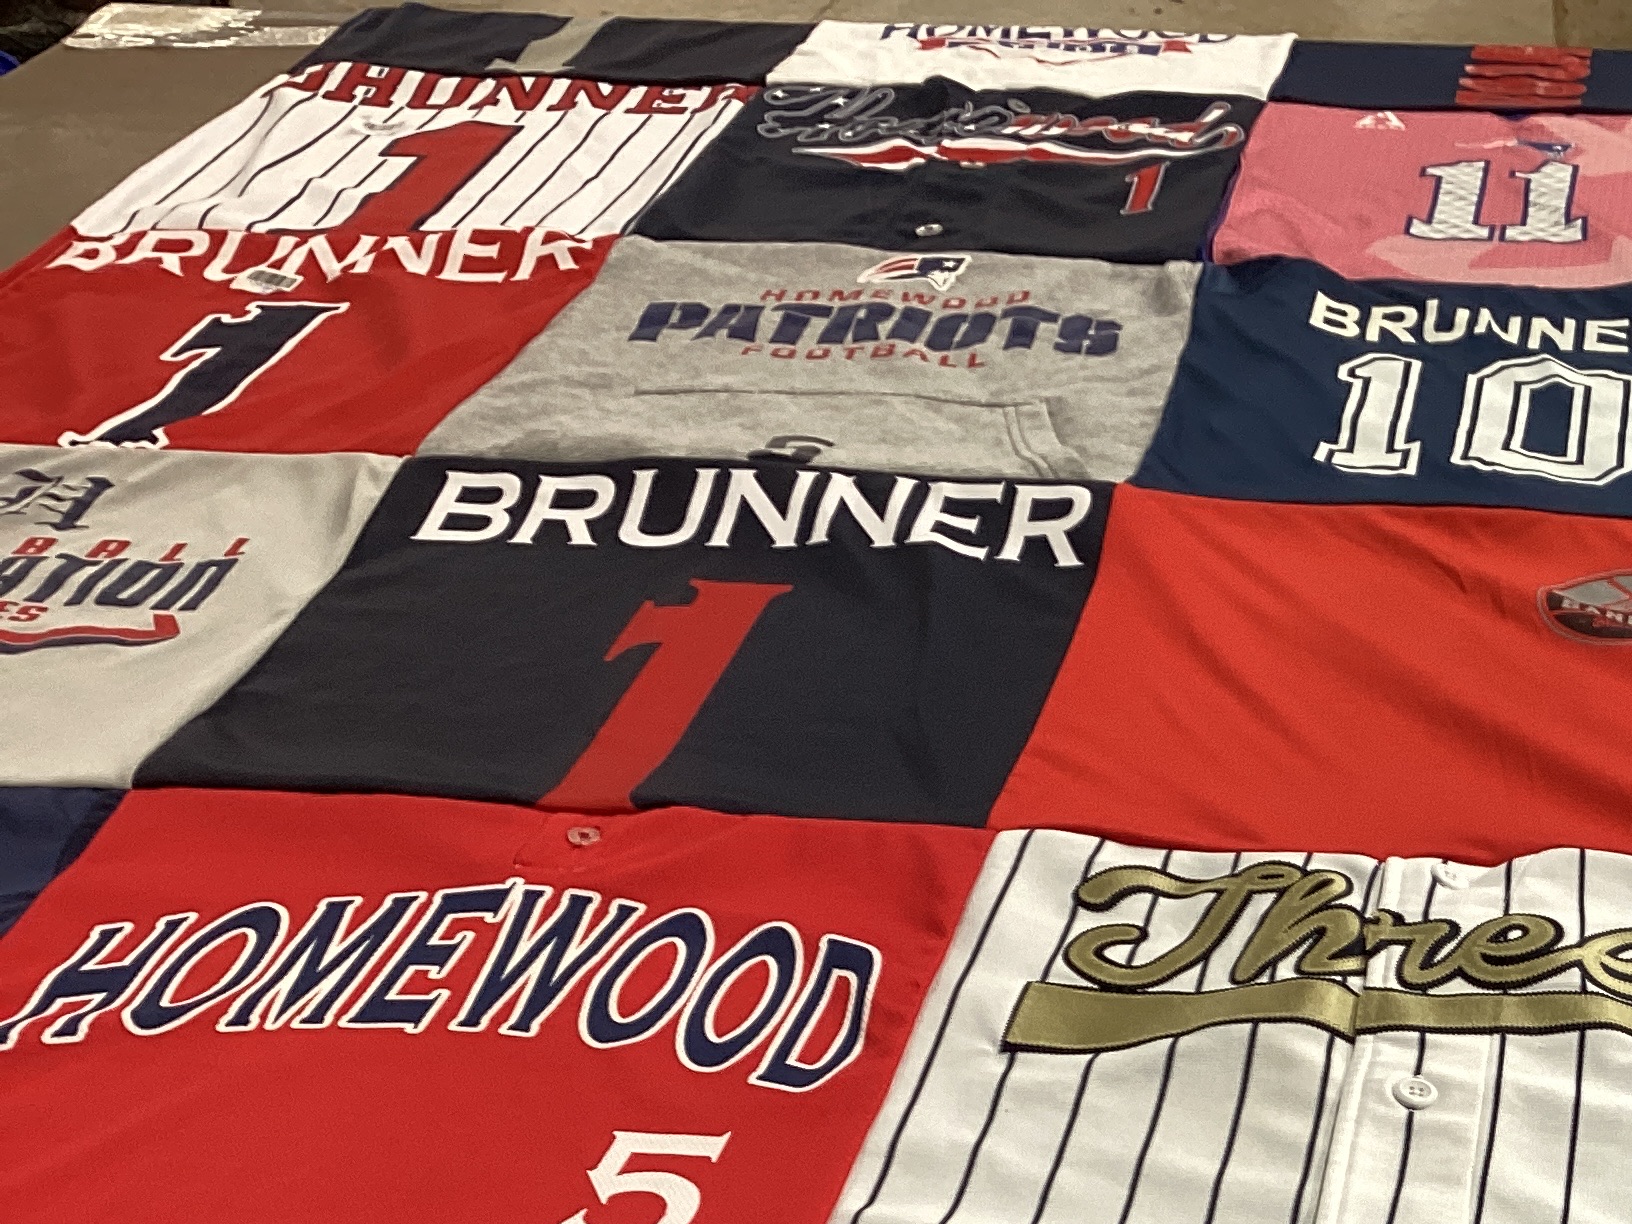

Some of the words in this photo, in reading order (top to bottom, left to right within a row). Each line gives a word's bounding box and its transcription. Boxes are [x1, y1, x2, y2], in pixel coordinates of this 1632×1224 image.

[1120, 161, 1169, 216] 1
[1404, 159, 1589, 243] 11
[627, 301, 1123, 356] PATRIOTS
[741, 343, 988, 369] FOOTBALL
[58, 301, 350, 450] 1
[409, 467, 1095, 567] BRUNNER
[535, 577, 794, 810] 1
[0, 877, 881, 1093] HOMEWOOD
